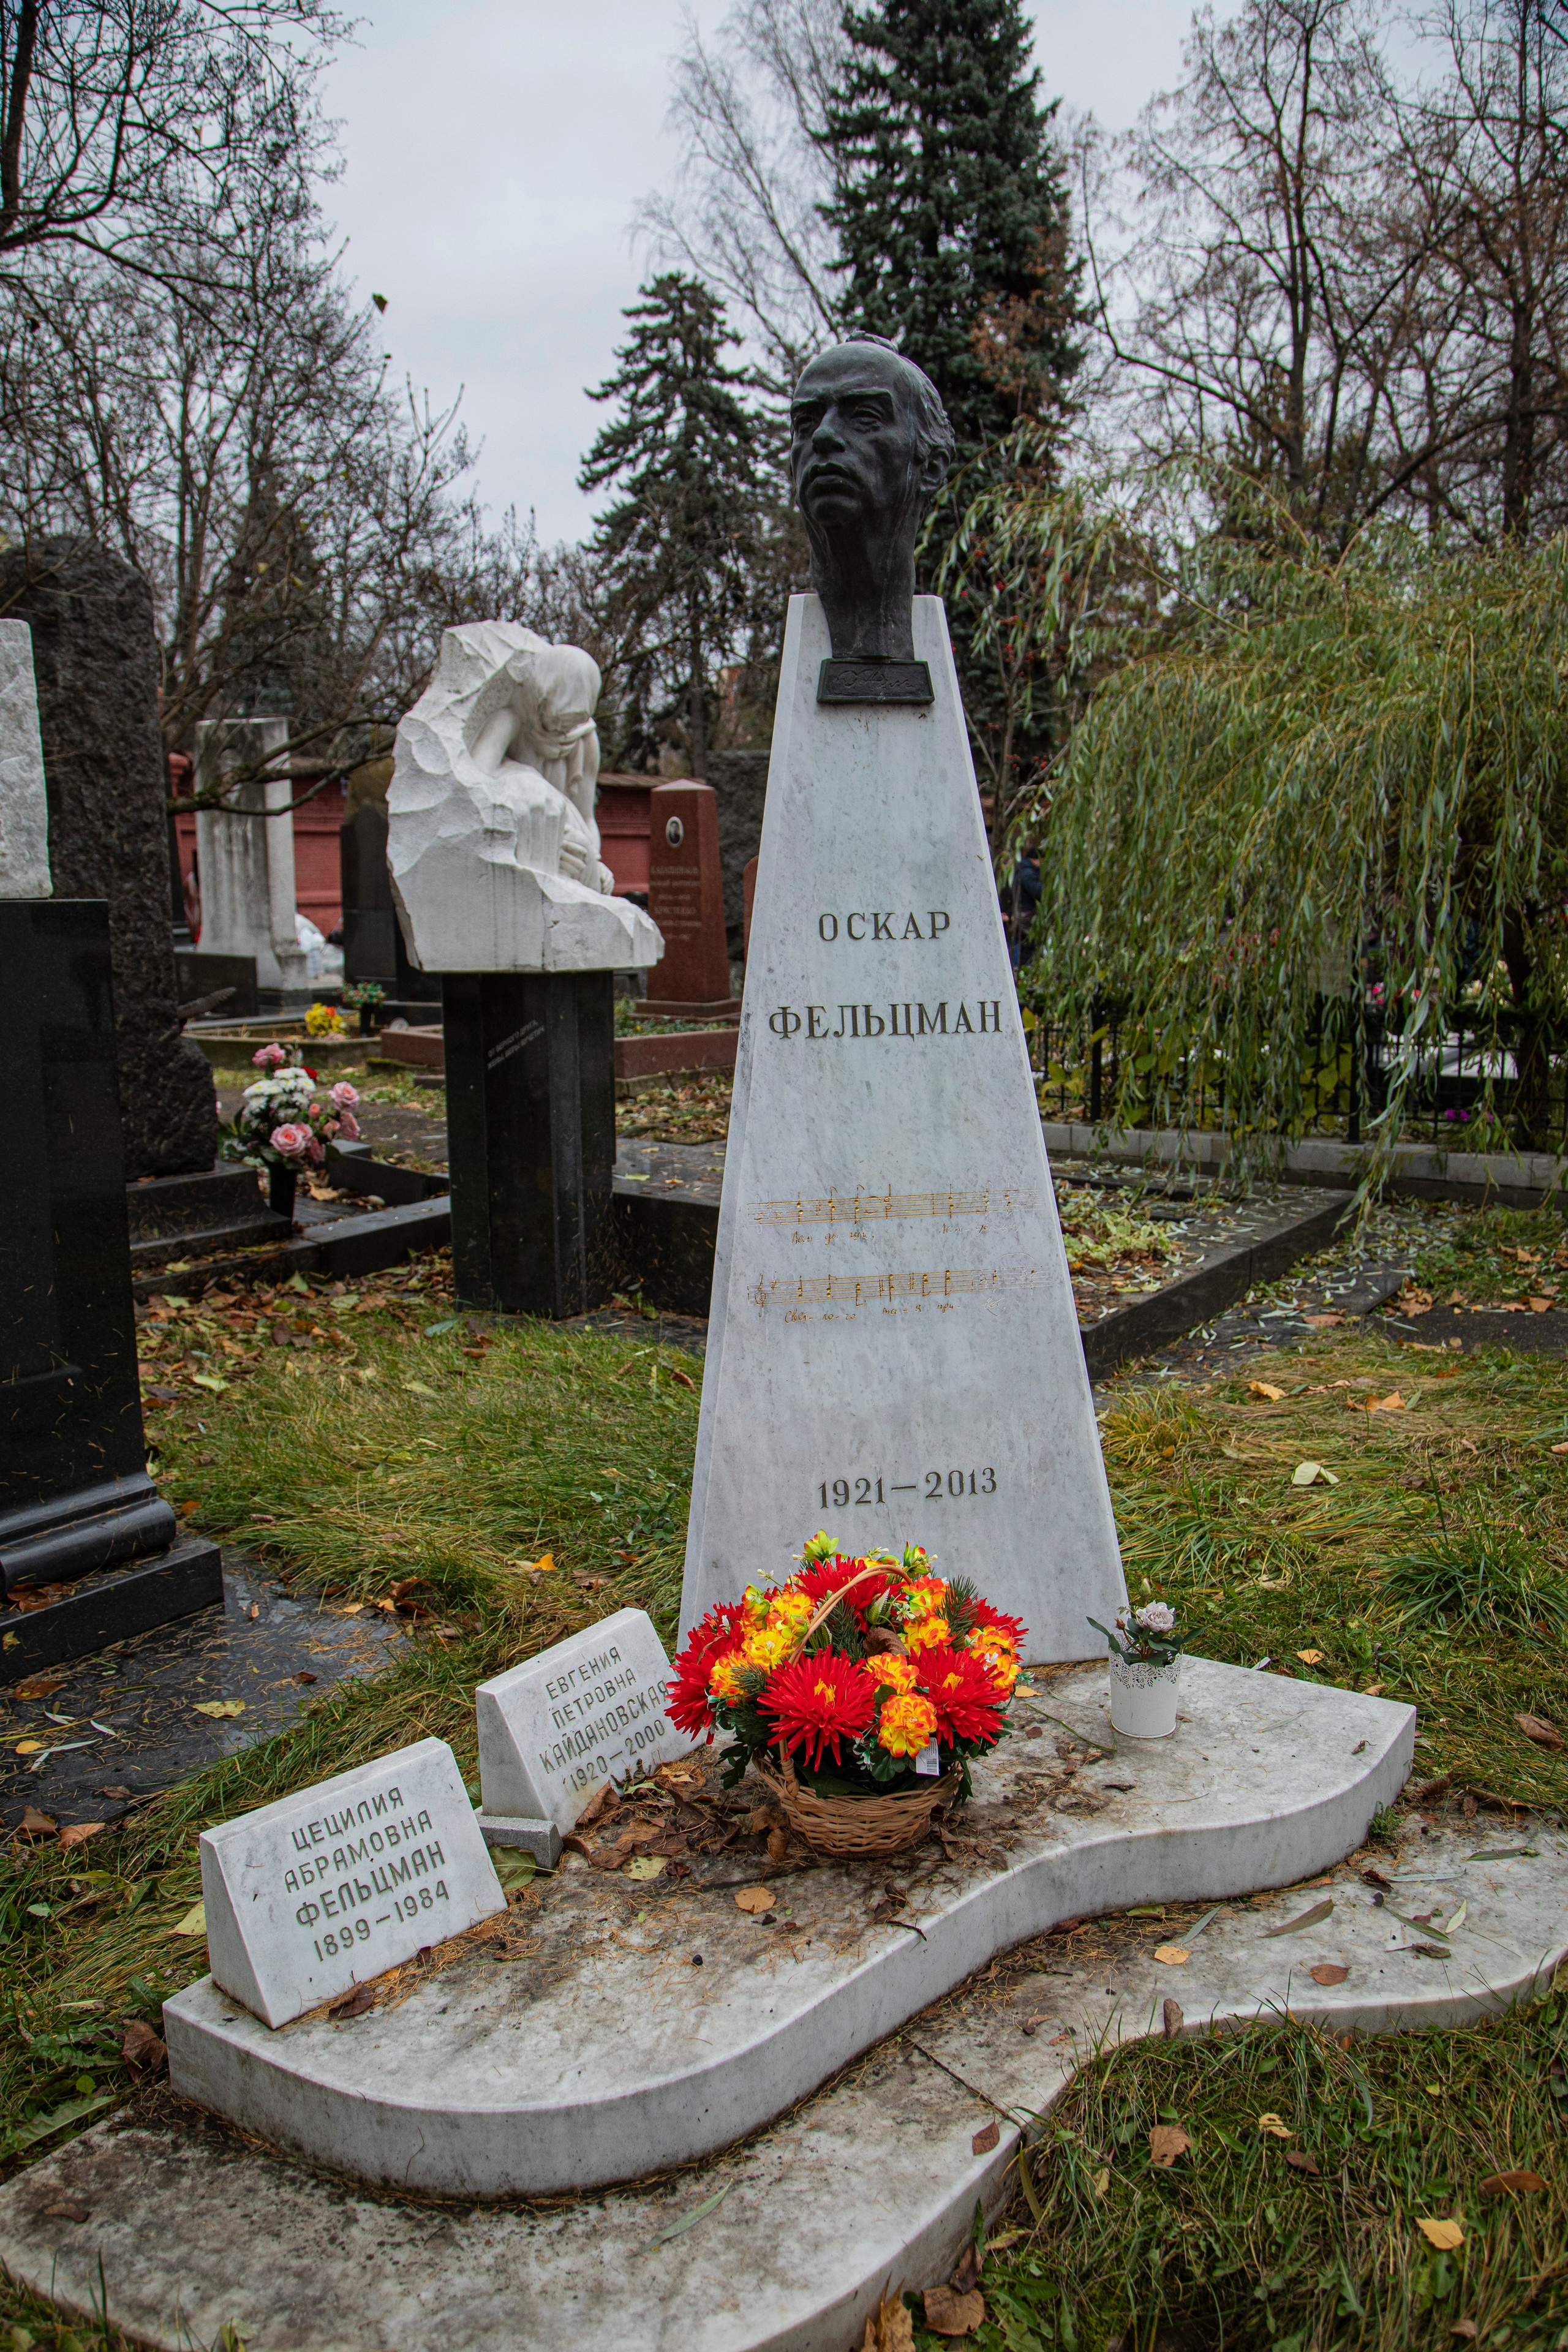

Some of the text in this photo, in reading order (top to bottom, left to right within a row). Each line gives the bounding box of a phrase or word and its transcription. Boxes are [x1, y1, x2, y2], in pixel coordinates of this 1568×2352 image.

[818, 911, 950, 941] ОСКАР
[769, 1000, 1003, 1041] ФЕЛЬЦМАН
[545, 1646, 622, 1700] ЕВГЕНИЯ
[551, 1668, 637, 1729] ПЕТРОВНА
[538, 1679, 669, 1774] КАЙДАНОВСКАЯ
[284, 1809, 433, 1893] АБРАМОВНА
[291, 1787, 404, 1852] ЦЕЦИЛИЯ
[295, 1841, 446, 1927] ФЕЛЬЦМАН
